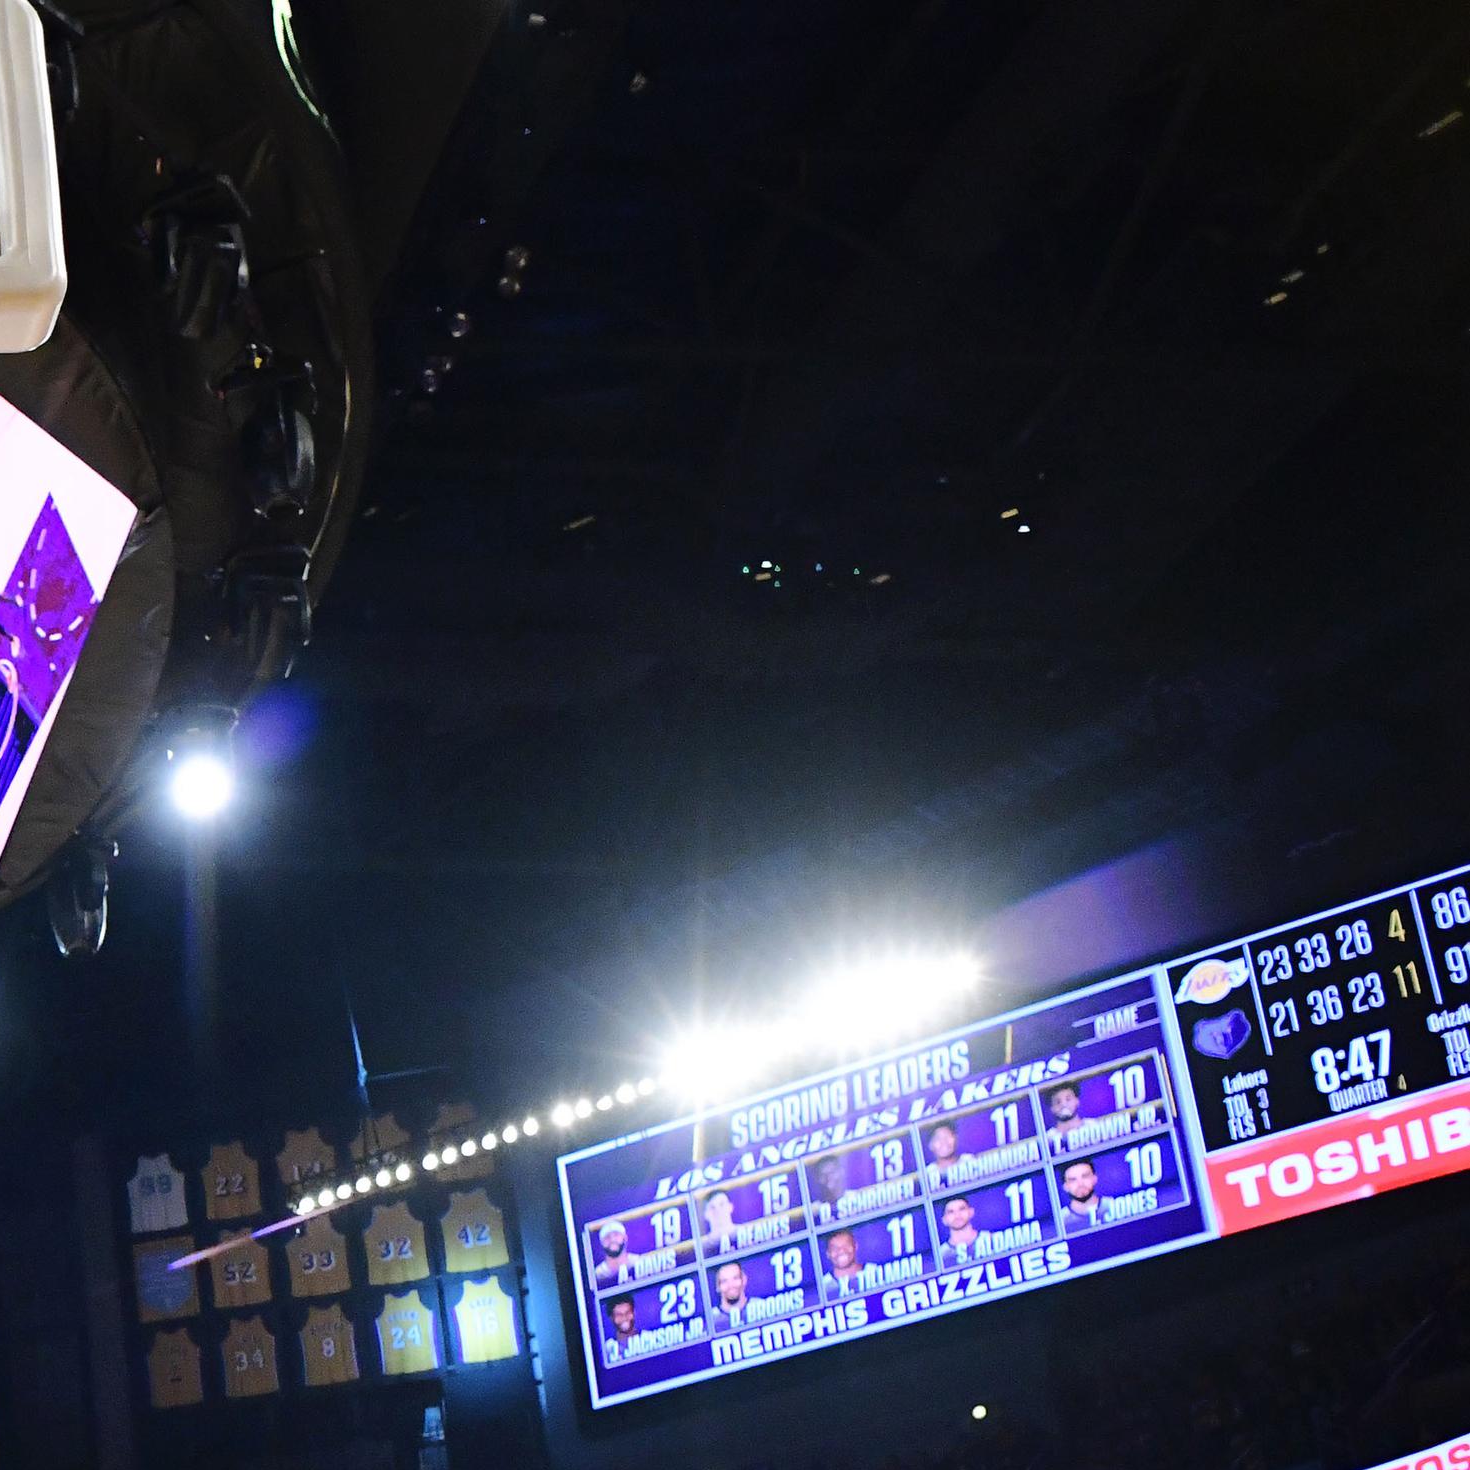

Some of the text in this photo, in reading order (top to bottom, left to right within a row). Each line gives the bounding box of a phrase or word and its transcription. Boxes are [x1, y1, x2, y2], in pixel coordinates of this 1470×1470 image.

[1257, 908, 1406, 986] 23 33 26 4
[1268, 960, 1422, 1039] 21 36 23 11
[730, 1040, 970, 1150] SCORING LEADERS
[1311, 1028, 1392, 1095] 8:47
[1328, 1078, 1389, 1113] QUARTER
[654, 1050, 1071, 1201] LOS ANGELES LAKERS
[1225, 1105, 1470, 1208] TOSHIB
[710, 1240, 1072, 1367] MEMPHIS GRIZZLIES
